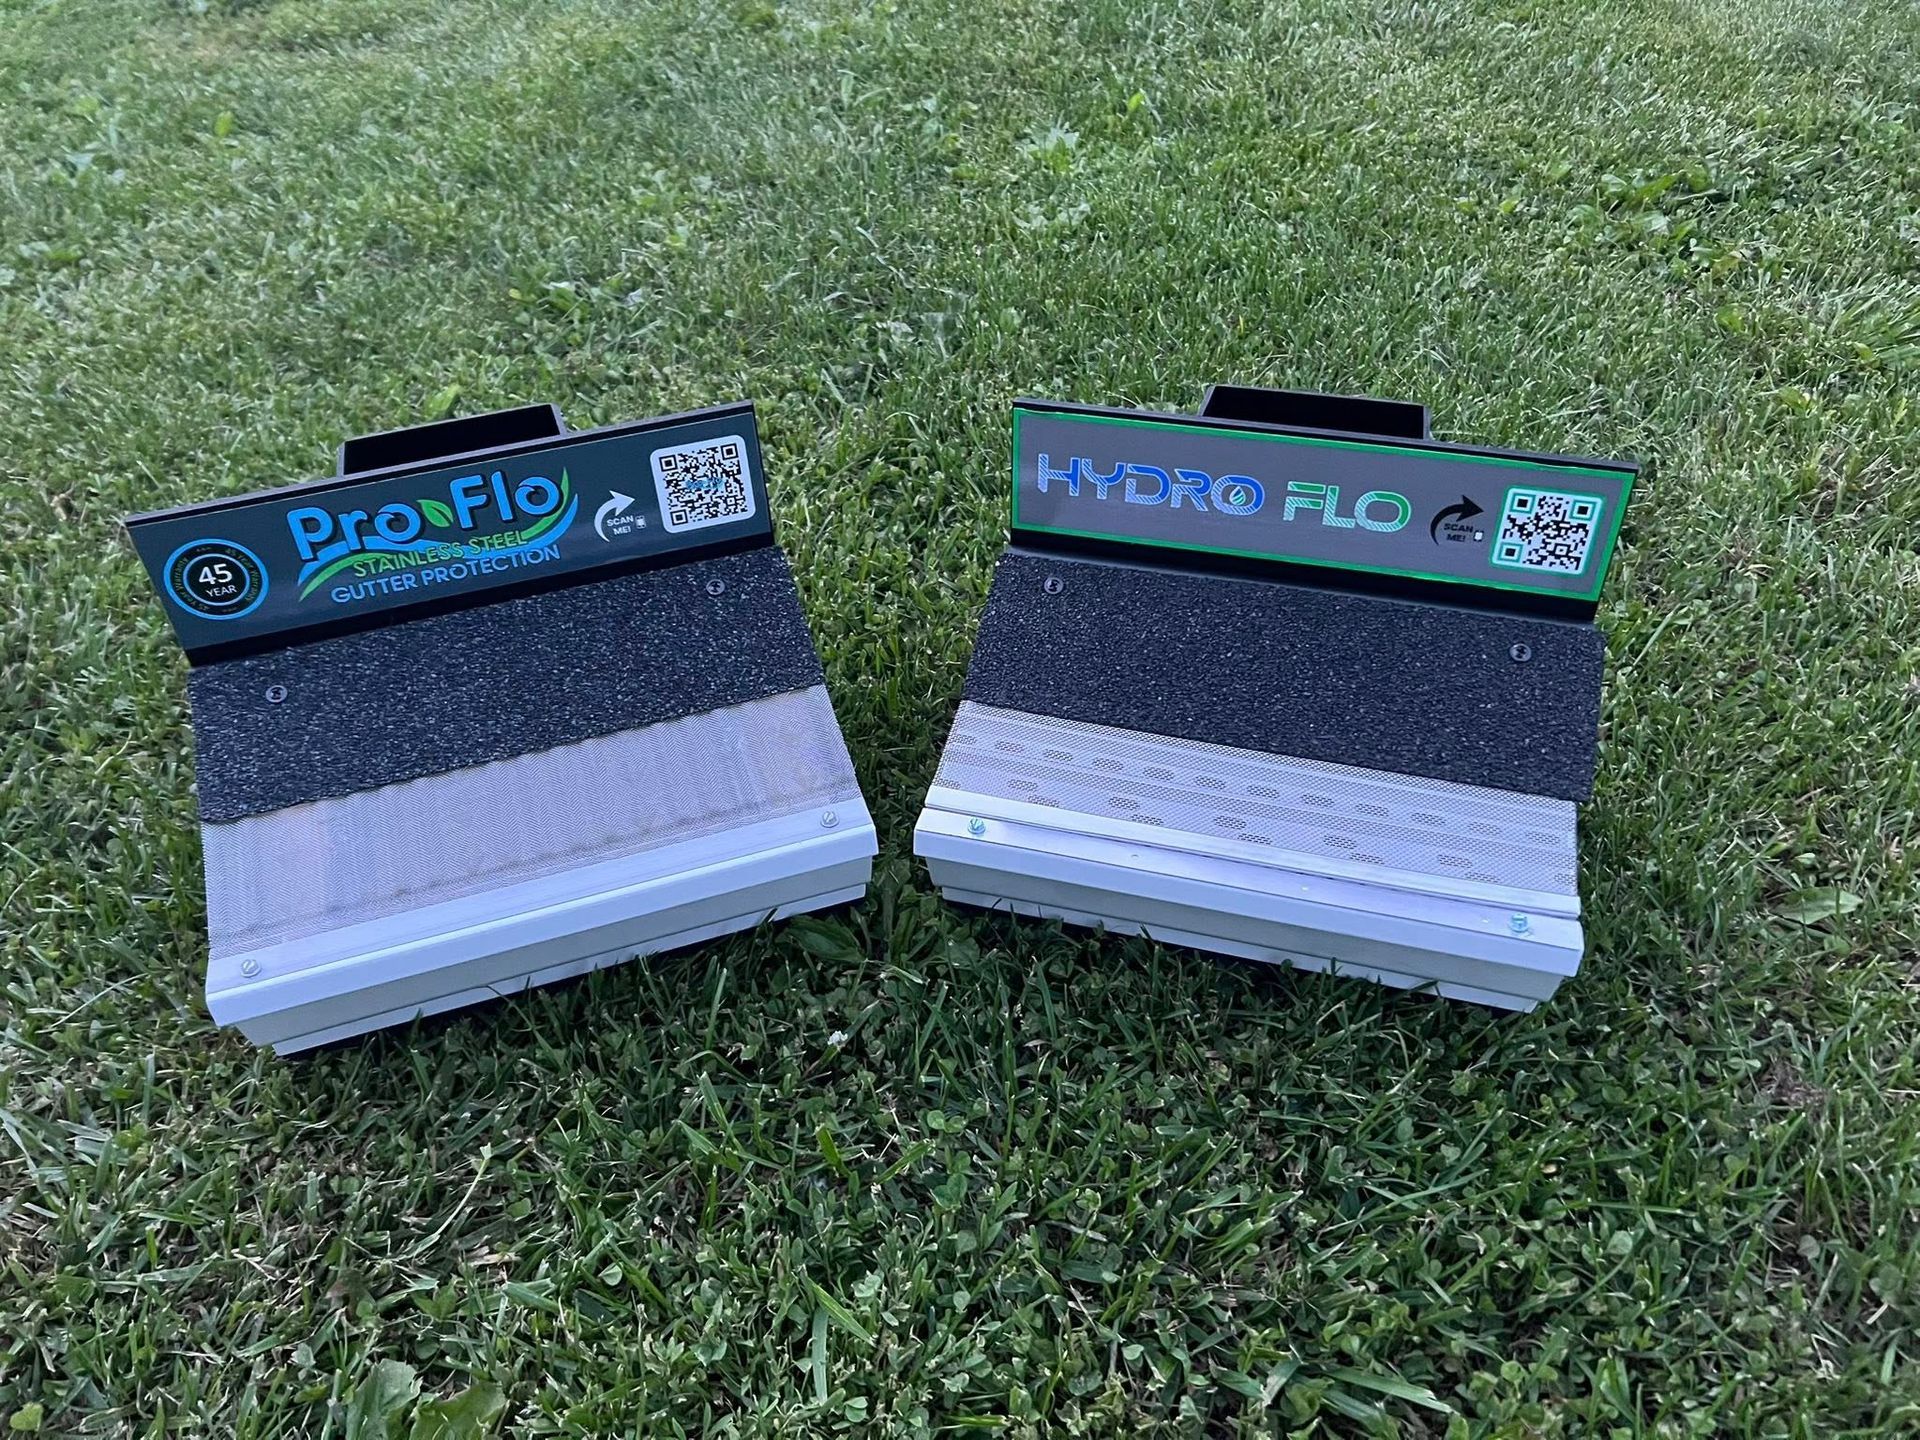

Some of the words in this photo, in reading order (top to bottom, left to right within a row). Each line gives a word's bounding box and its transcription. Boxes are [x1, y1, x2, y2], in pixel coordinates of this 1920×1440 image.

[1037, 452, 1265, 516] HYDRO
[1283, 480, 1412, 533] FLO
[286, 502, 422, 562] Pro
[450, 470, 560, 531] Flo
[606, 514, 635, 528] SCAN
[613, 525, 632, 536] ME!
[1443, 522, 1474, 534] SCAN
[1446, 533, 1466, 543] ME!
[352, 540, 464, 578] STAINLESS
[469, 530, 529, 556] STEEL
[198, 563, 233, 585] 45
[330, 570, 419, 603] GUTTER
[421, 544, 561, 588] PROTECTION
[205, 584, 238, 598] YEAR
